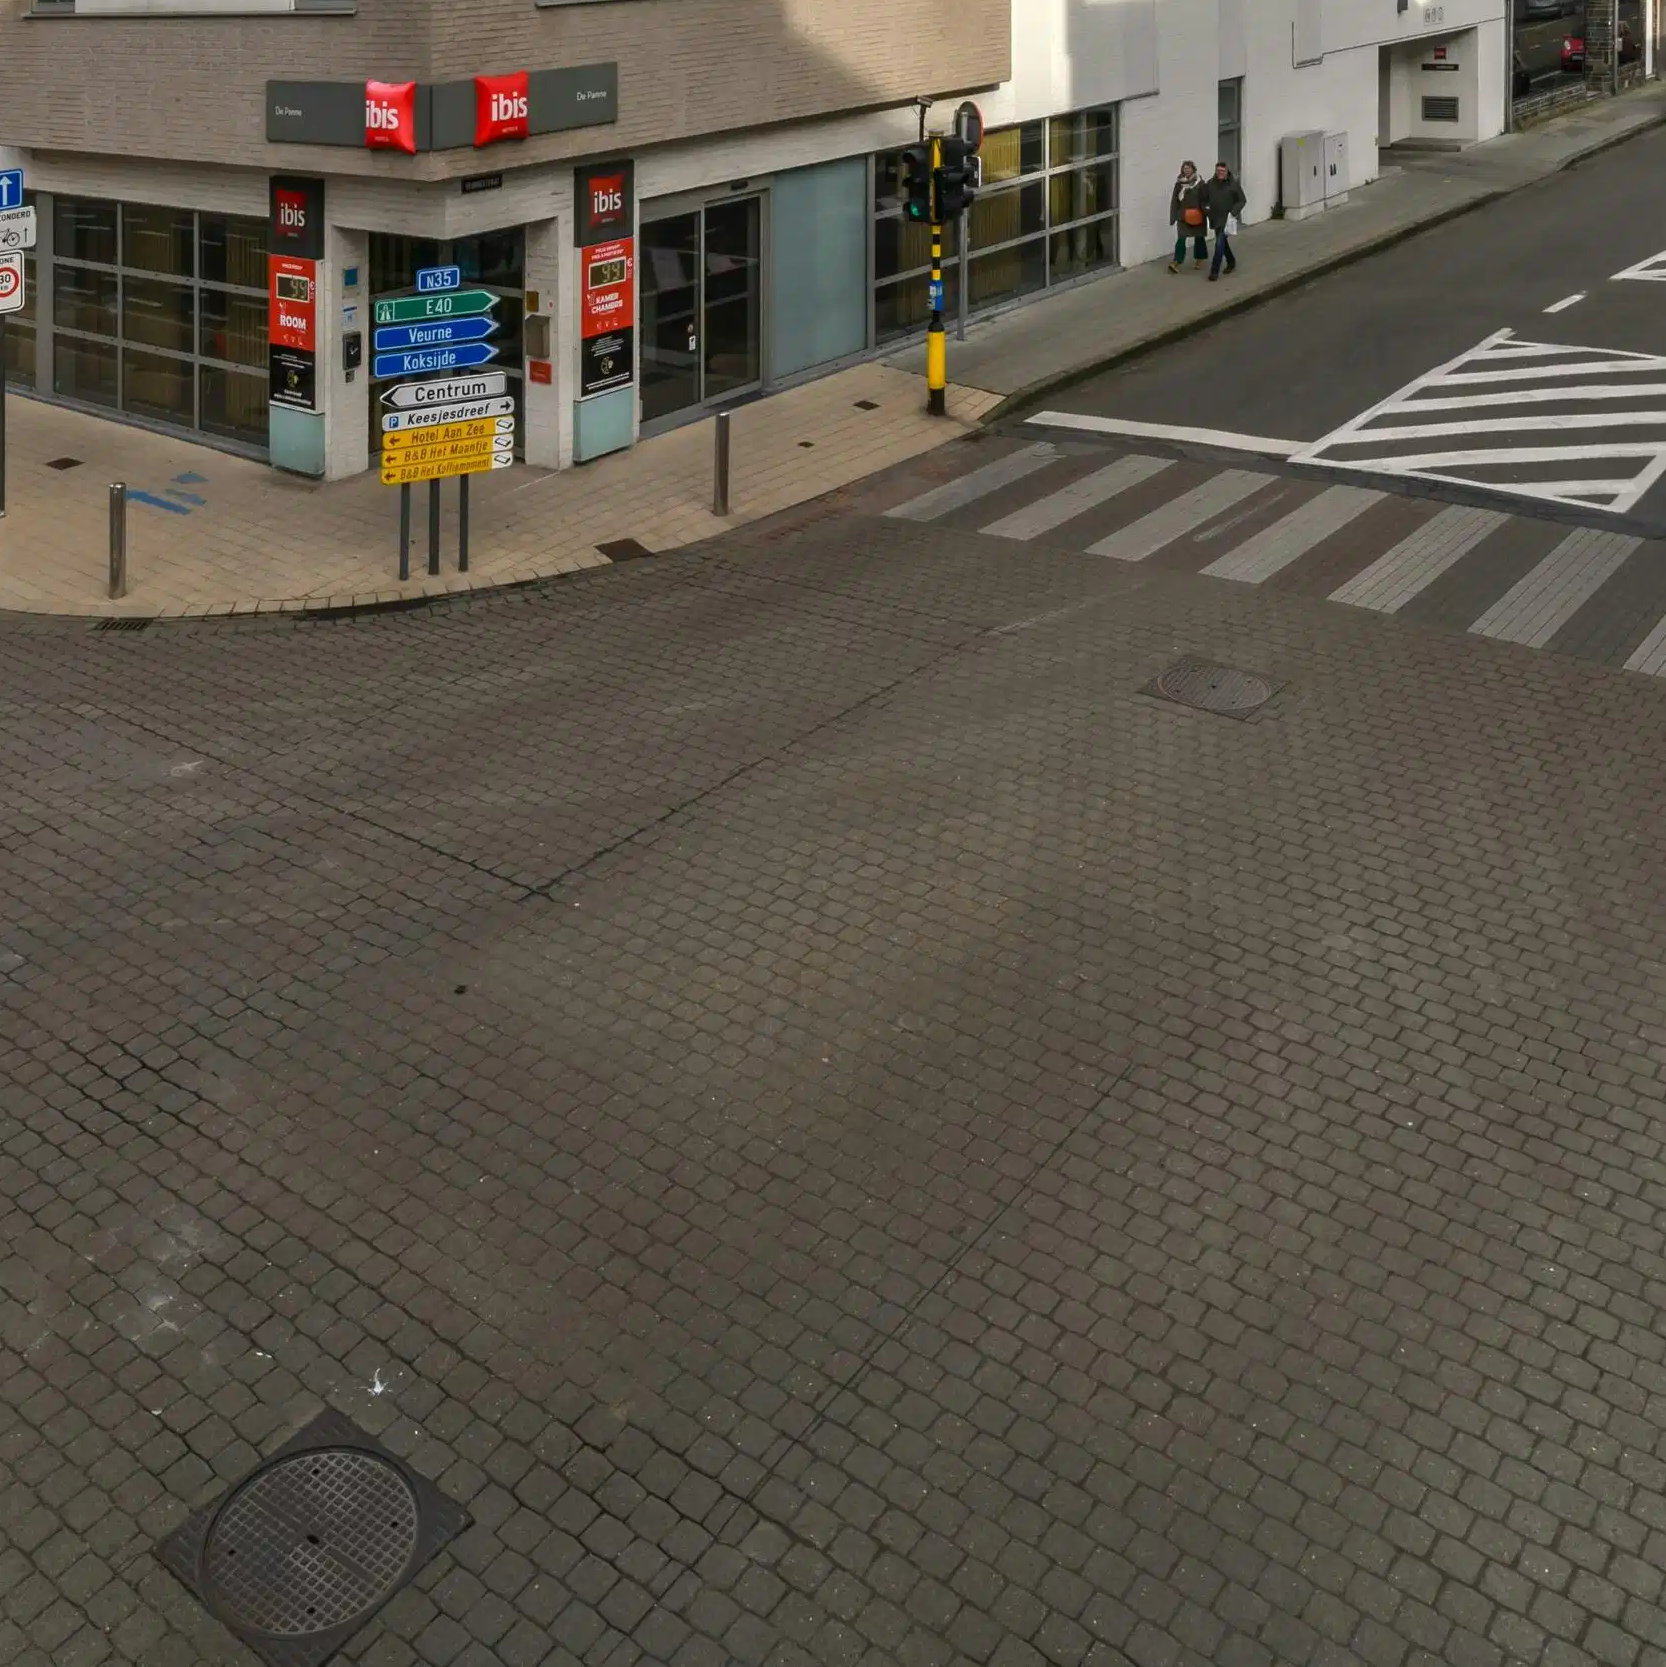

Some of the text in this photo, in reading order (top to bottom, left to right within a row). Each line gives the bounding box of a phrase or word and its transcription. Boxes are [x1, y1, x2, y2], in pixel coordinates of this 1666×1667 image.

[576, 89, 608, 102] De Panne
[365, 99, 399, 130] ibis
[491, 93, 528, 122] ibis
[594, 190, 622, 214] ibis
[280, 203, 306, 227] ibis
[426, 272, 451, 289] N35
[426, 297, 452, 315] E40
[280, 314, 306, 330] ROOM
[409, 326, 452, 343] Veurne
[403, 352, 456, 370] Koksijde
[415, 381, 486, 402] Centrum
[407, 403, 491, 425] Keesjesdreef
[411, 423, 485, 444] Hotel Aan Zee
[404, 439, 488, 462] B&B Het Maantje
[400, 465, 420, 480] B&B
[420, 462, 435, 477] Het
